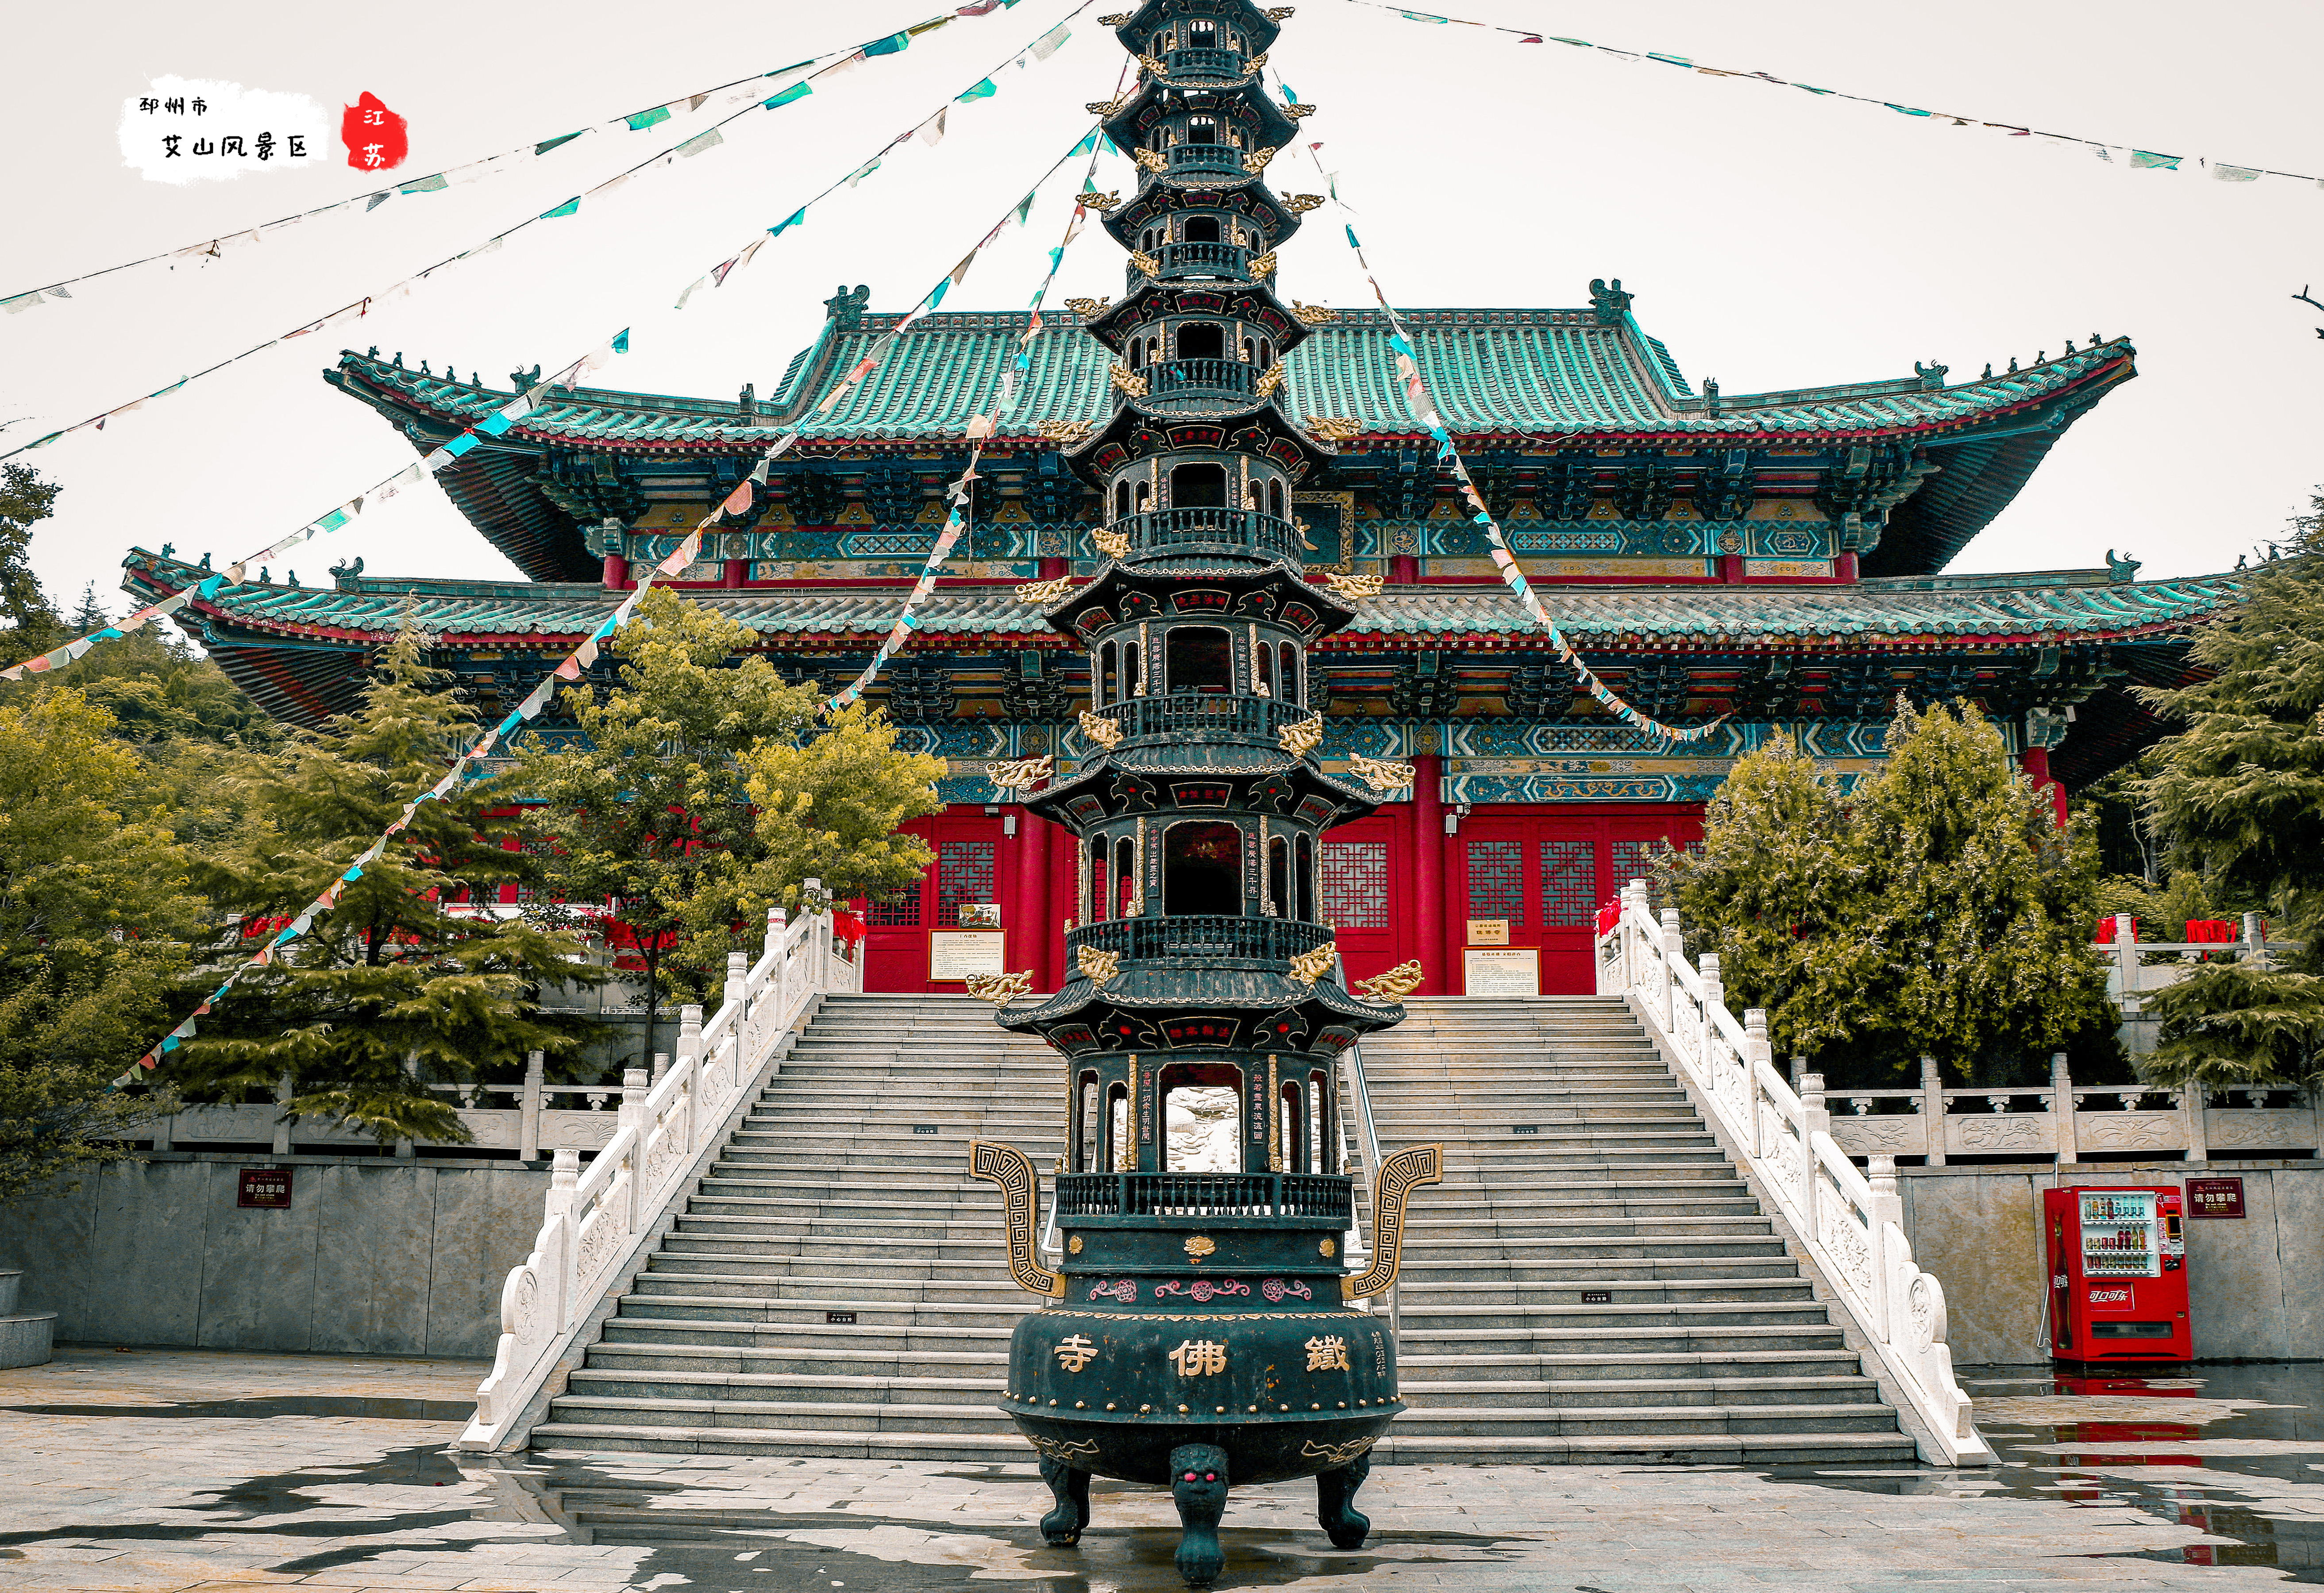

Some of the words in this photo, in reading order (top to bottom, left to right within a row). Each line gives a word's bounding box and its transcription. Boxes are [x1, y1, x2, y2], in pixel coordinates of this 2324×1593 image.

[246, 1184, 285, 1193] 请勿攀爬
[2194, 1193, 2237, 1202] 请勿攀爬
[2089, 1290, 2129, 1303] 可口可乐
